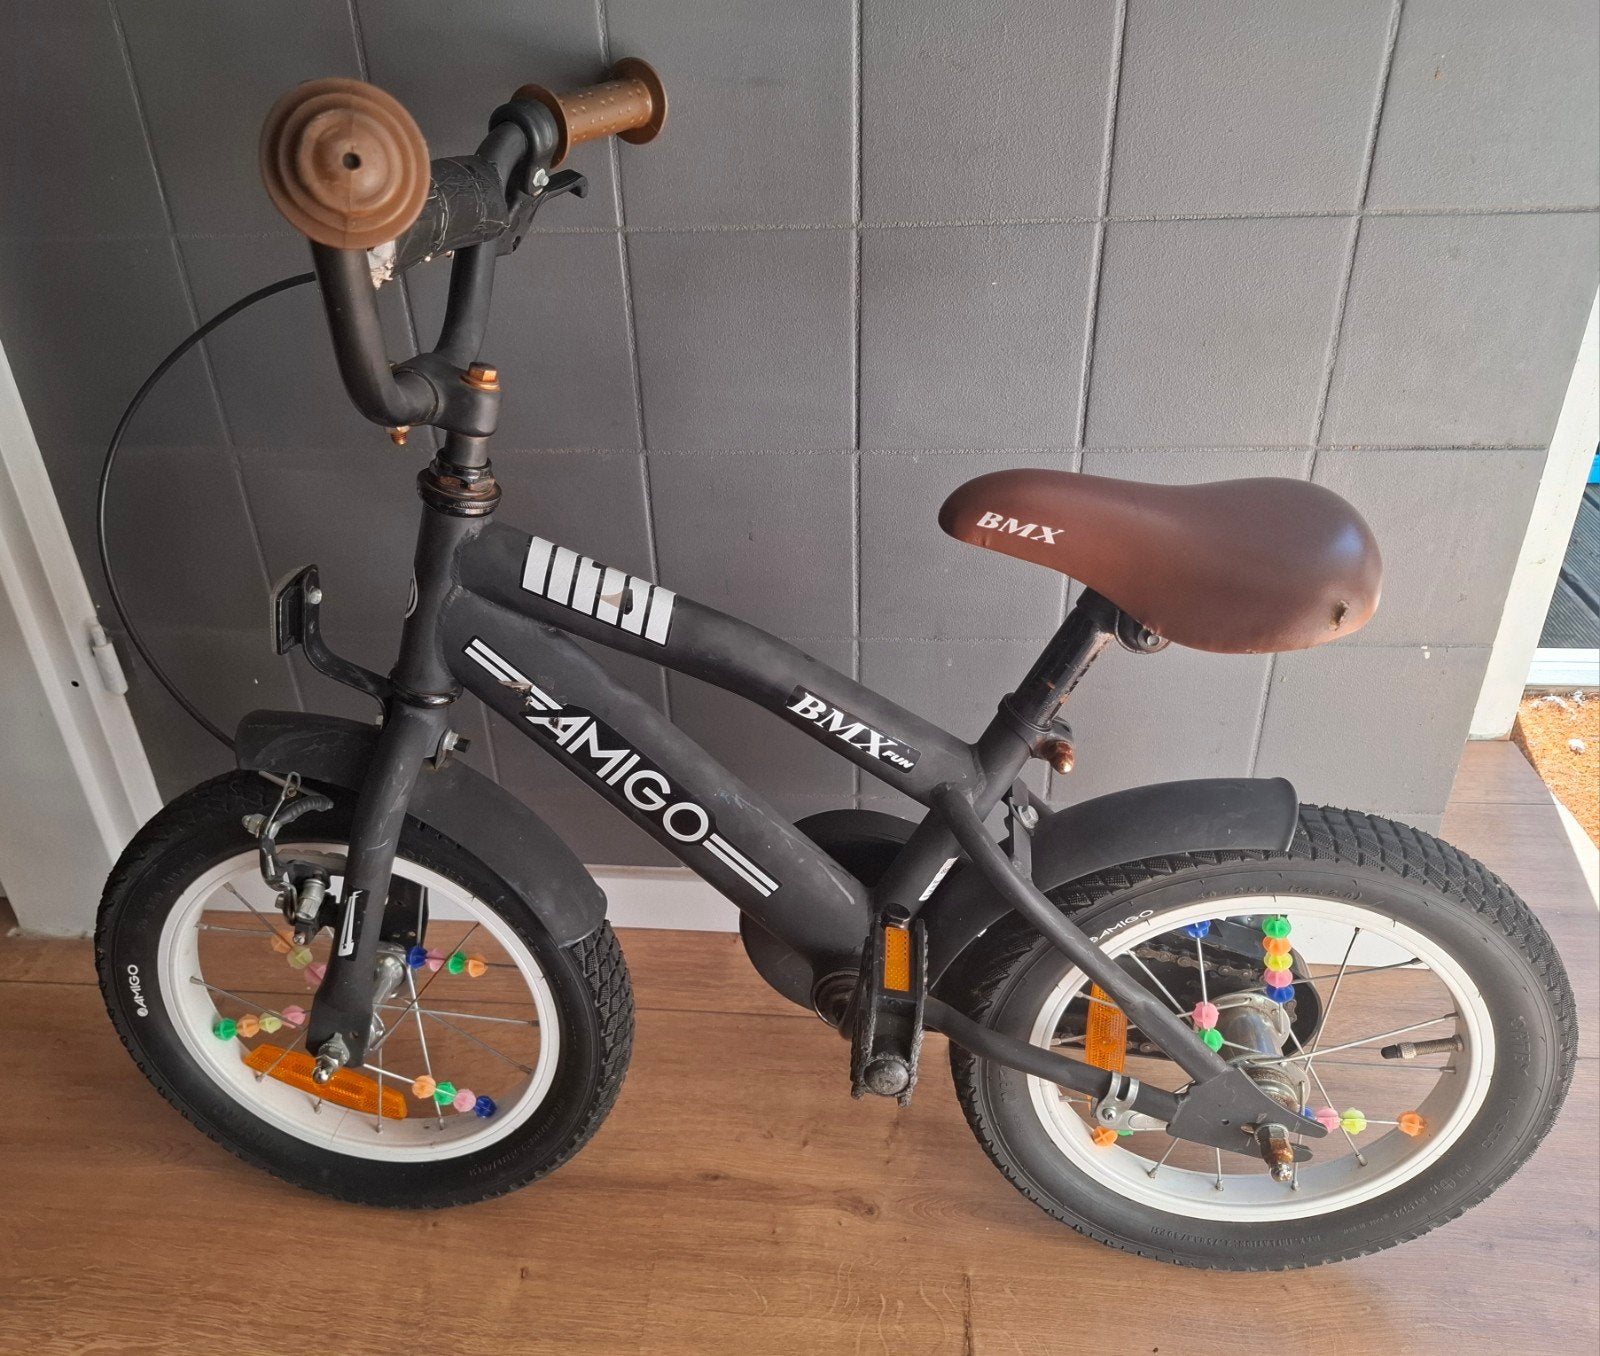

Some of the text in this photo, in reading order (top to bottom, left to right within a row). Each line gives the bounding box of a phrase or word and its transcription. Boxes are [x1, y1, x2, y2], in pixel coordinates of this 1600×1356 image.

[976, 511, 1065, 545] BMX
[787, 692, 915, 769] BMX FUN
[527, 716, 709, 842] AMIGO
[1099, 910, 1154, 940] AMIGO
[127, 964, 147, 1008] AMIGO
